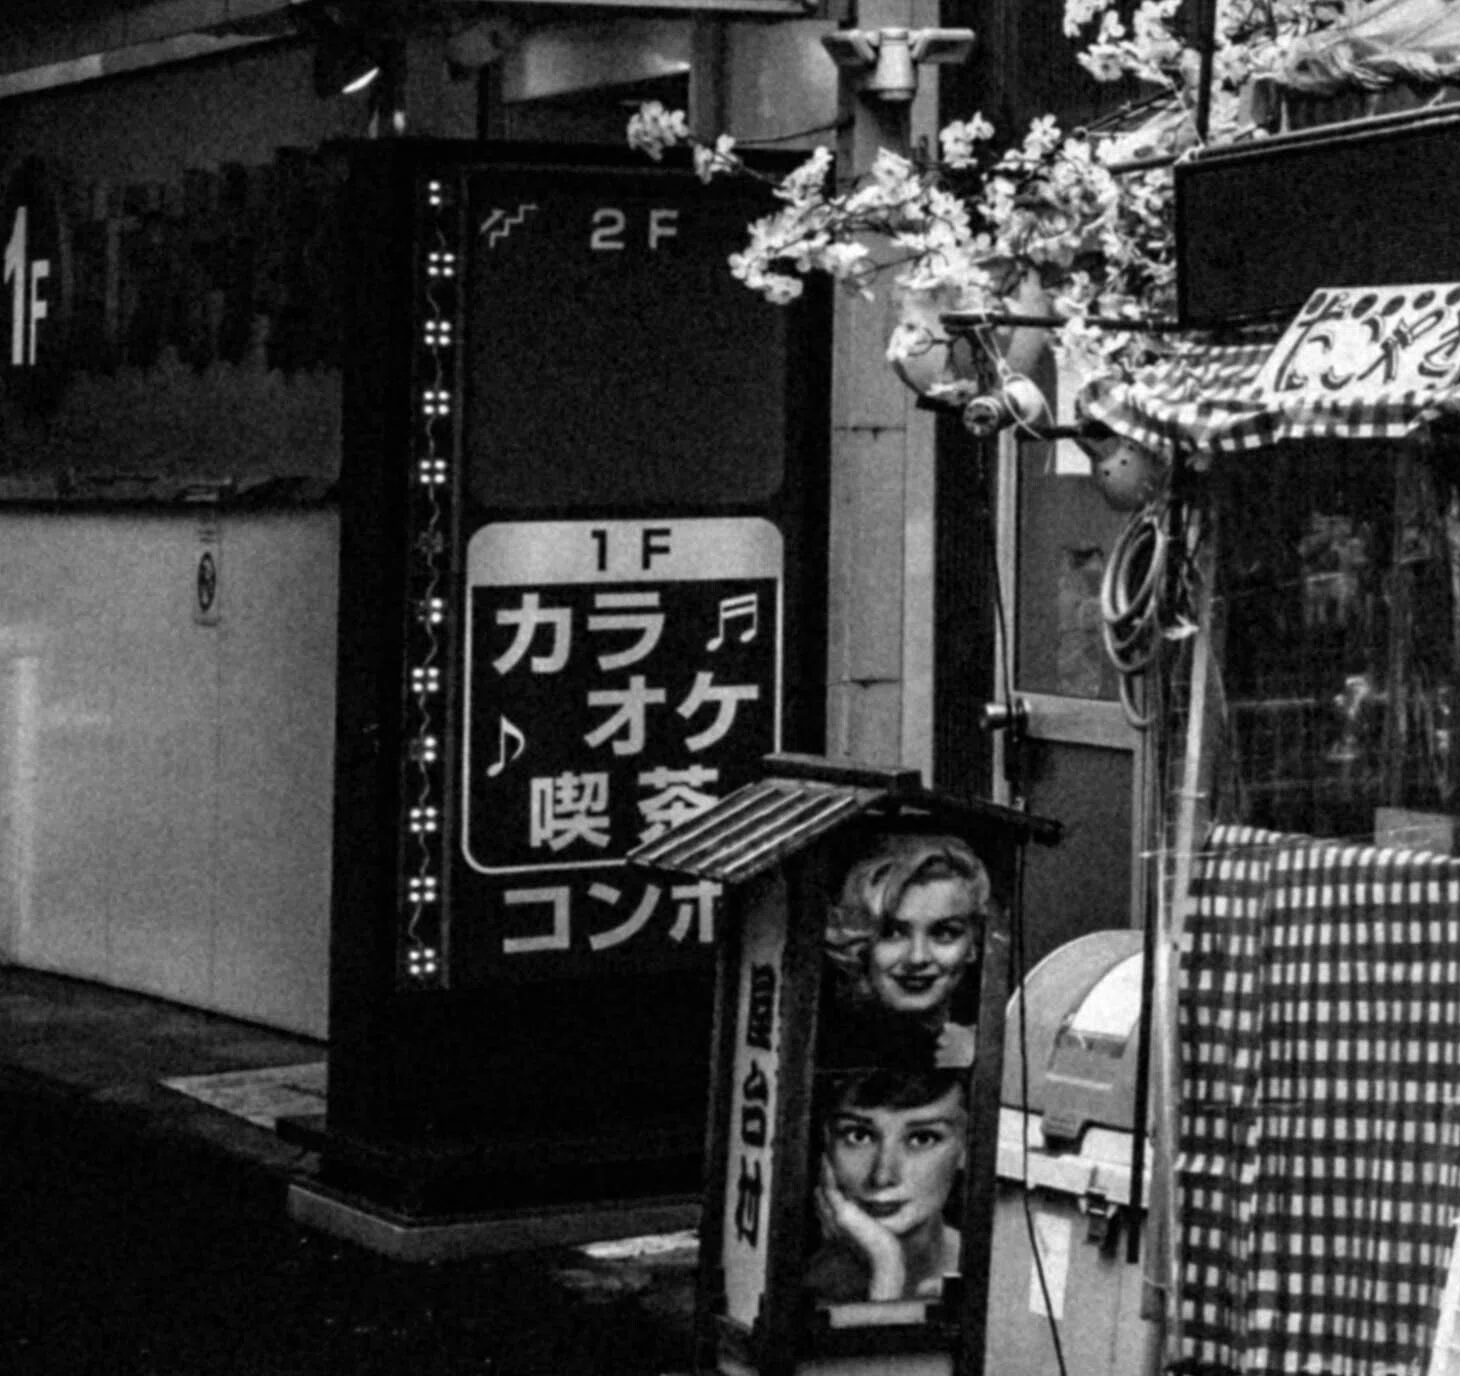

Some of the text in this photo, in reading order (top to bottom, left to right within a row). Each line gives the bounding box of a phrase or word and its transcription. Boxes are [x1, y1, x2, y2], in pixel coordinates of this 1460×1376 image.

[590, 207, 679, 252] 2F
[4, 204, 50, 365] 1F
[590, 527, 672, 573] 1F
[492, 592, 666, 674] カラ
[584, 672, 759, 756] オケ
[529, 765, 719, 852] 喫茶
